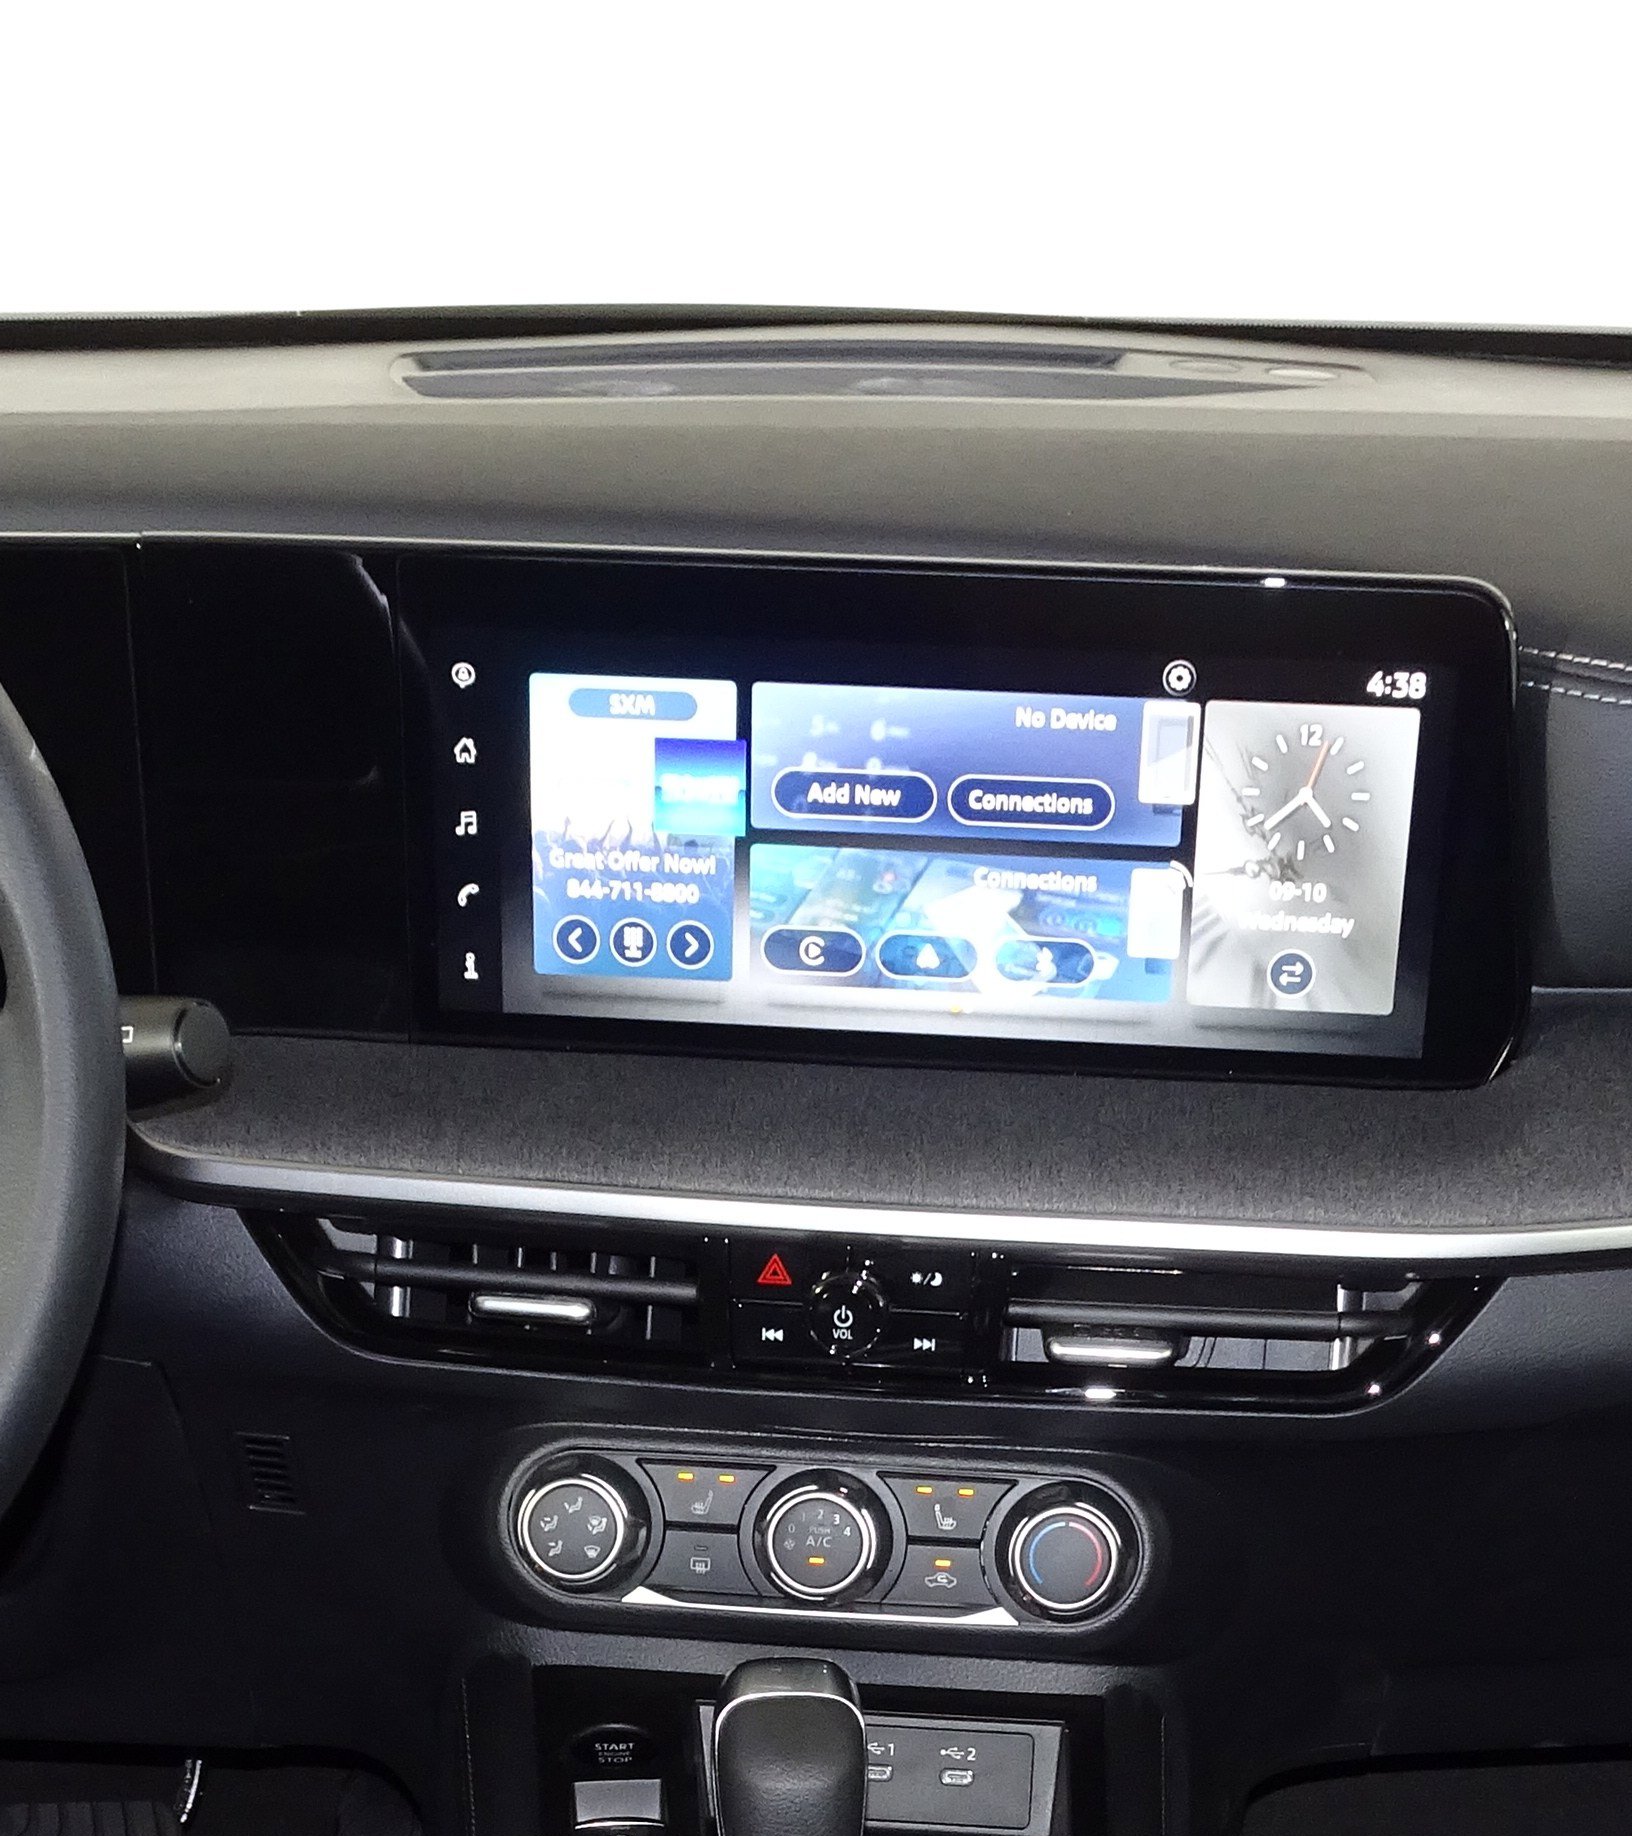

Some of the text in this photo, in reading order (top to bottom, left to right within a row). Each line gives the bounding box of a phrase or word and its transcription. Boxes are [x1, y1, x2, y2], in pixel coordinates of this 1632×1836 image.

[1366, 671, 1427, 699] 4:38
[609, 693, 656, 717] SXM
[1015, 706, 1118, 732] No Device
[1299, 723, 1323, 747] 12
[807, 781, 902, 807] Add New
[968, 789, 1094, 815] Connections
[549, 847, 717, 875] Great Offer Now!
[973, 867, 1099, 893] Connections
[1269, 880, 1328, 903] 09-10
[832, 1328, 853, 1340] VOL
[817, 1508, 824, 1520] 2
[833, 1513, 840, 1525] 3
[809, 1525, 831, 1534] PUSH
[843, 1526, 851, 1537] 4
[806, 1535, 833, 1548] A/C
[594, 1742, 636, 1751] START
[887, 1743, 895, 1756] 1
[598, 1756, 633, 1764] STOP
[966, 1747, 976, 1761] 2
